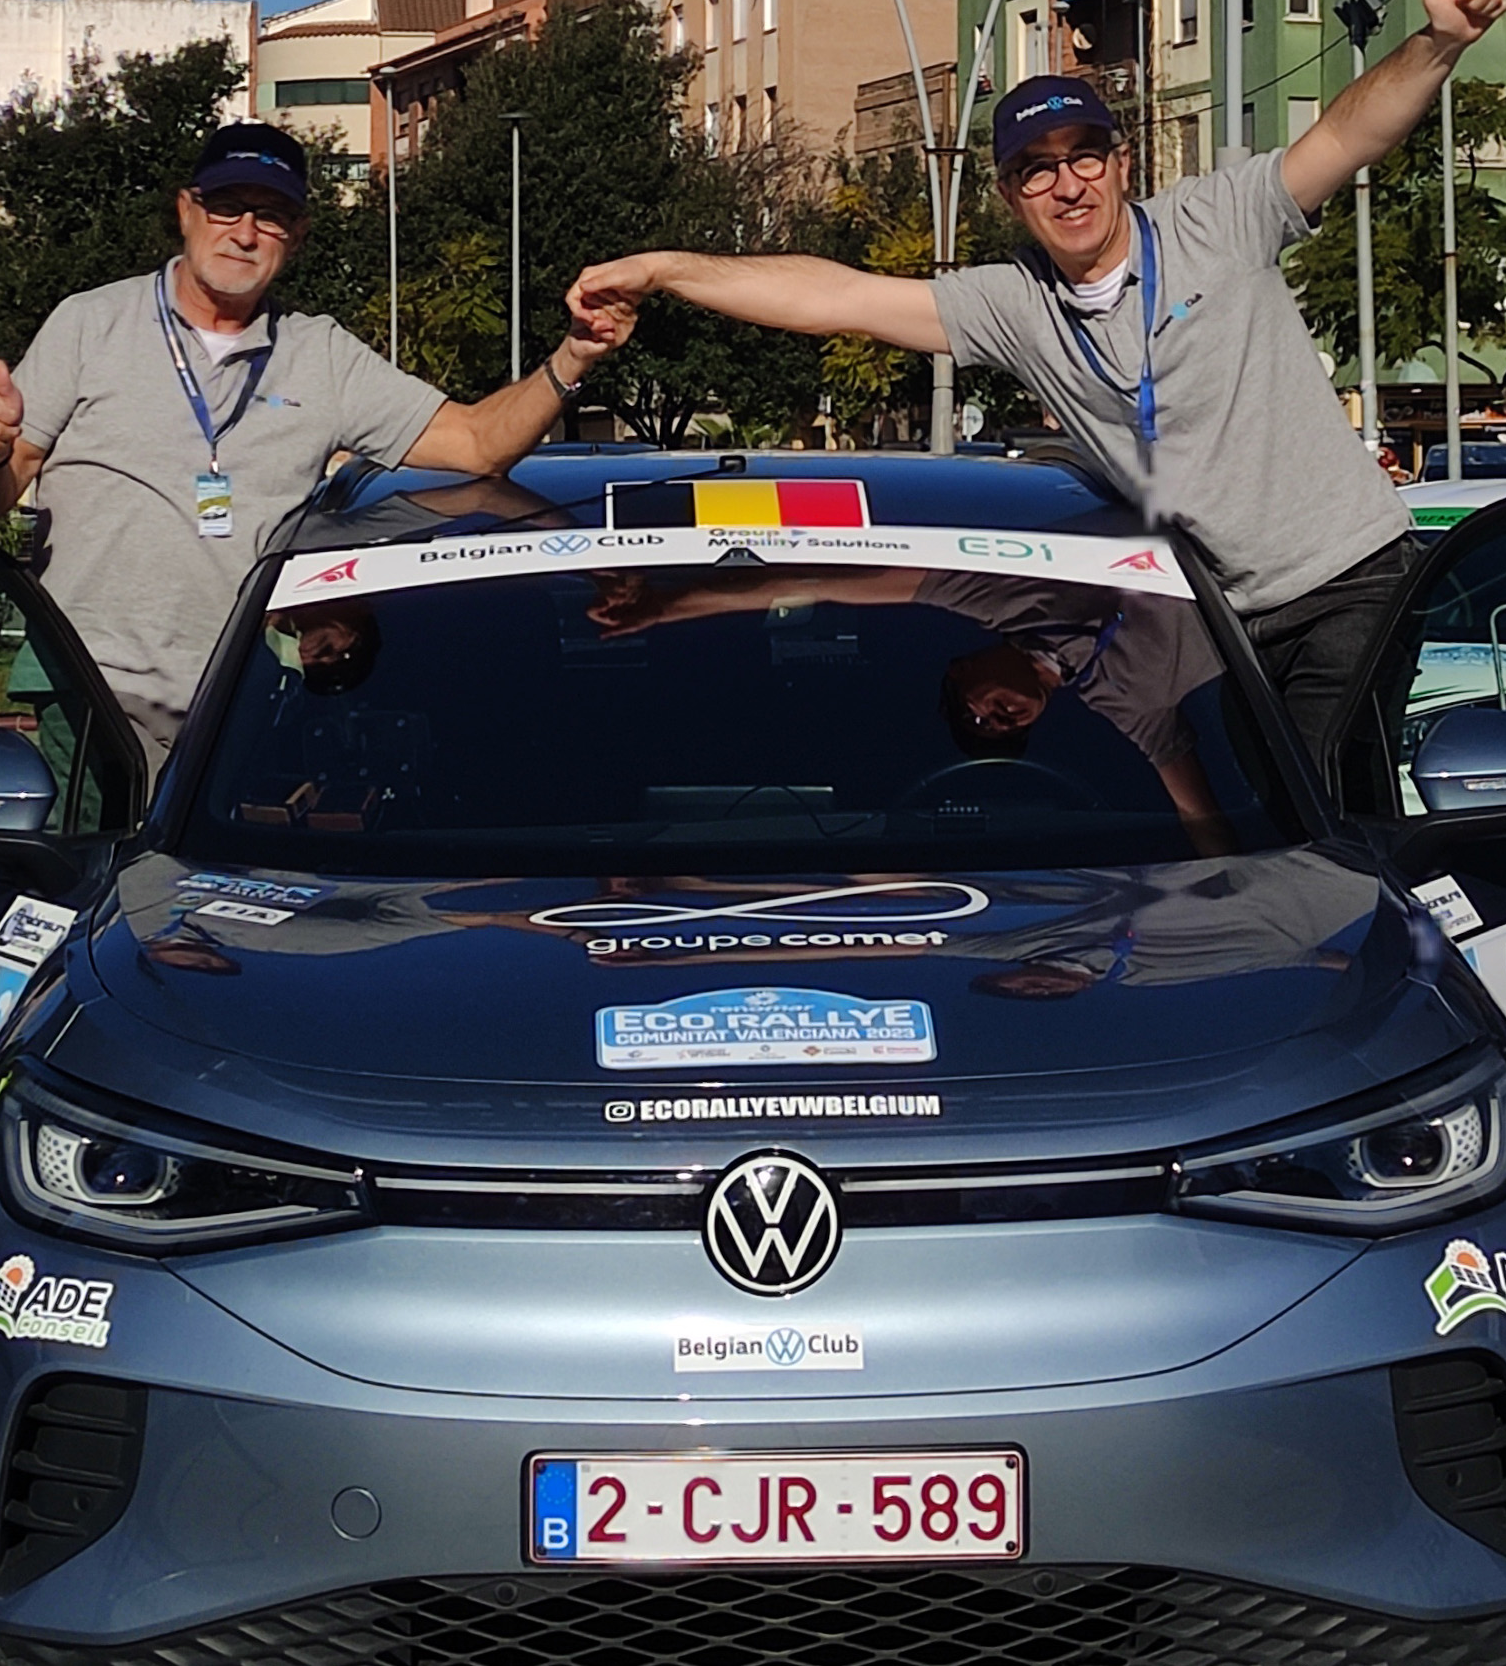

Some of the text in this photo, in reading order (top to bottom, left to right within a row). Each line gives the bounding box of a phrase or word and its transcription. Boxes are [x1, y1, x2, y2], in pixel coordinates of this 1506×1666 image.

[708, 538, 911, 550] Mobility Solutions
[709, 529, 781, 538] Group
[420, 542, 533, 563] Belgian
[597, 534, 664, 546] Club
[585, 931, 948, 955] groupe comet
[614, 1005, 914, 1031] ECO RALLYE
[615, 1027, 916, 1045] COMUNITAT VALENCIANA 2023
[640, 1095, 940, 1120] ECORALLYEVWBELGIUM
[25, 1282, 108, 1319] ADE
[678, 1337, 763, 1361] Belgian
[808, 1334, 859, 1354] Club
[588, 1474, 1006, 1543] 2-CJR-589
[544, 1518, 569, 1548] B
